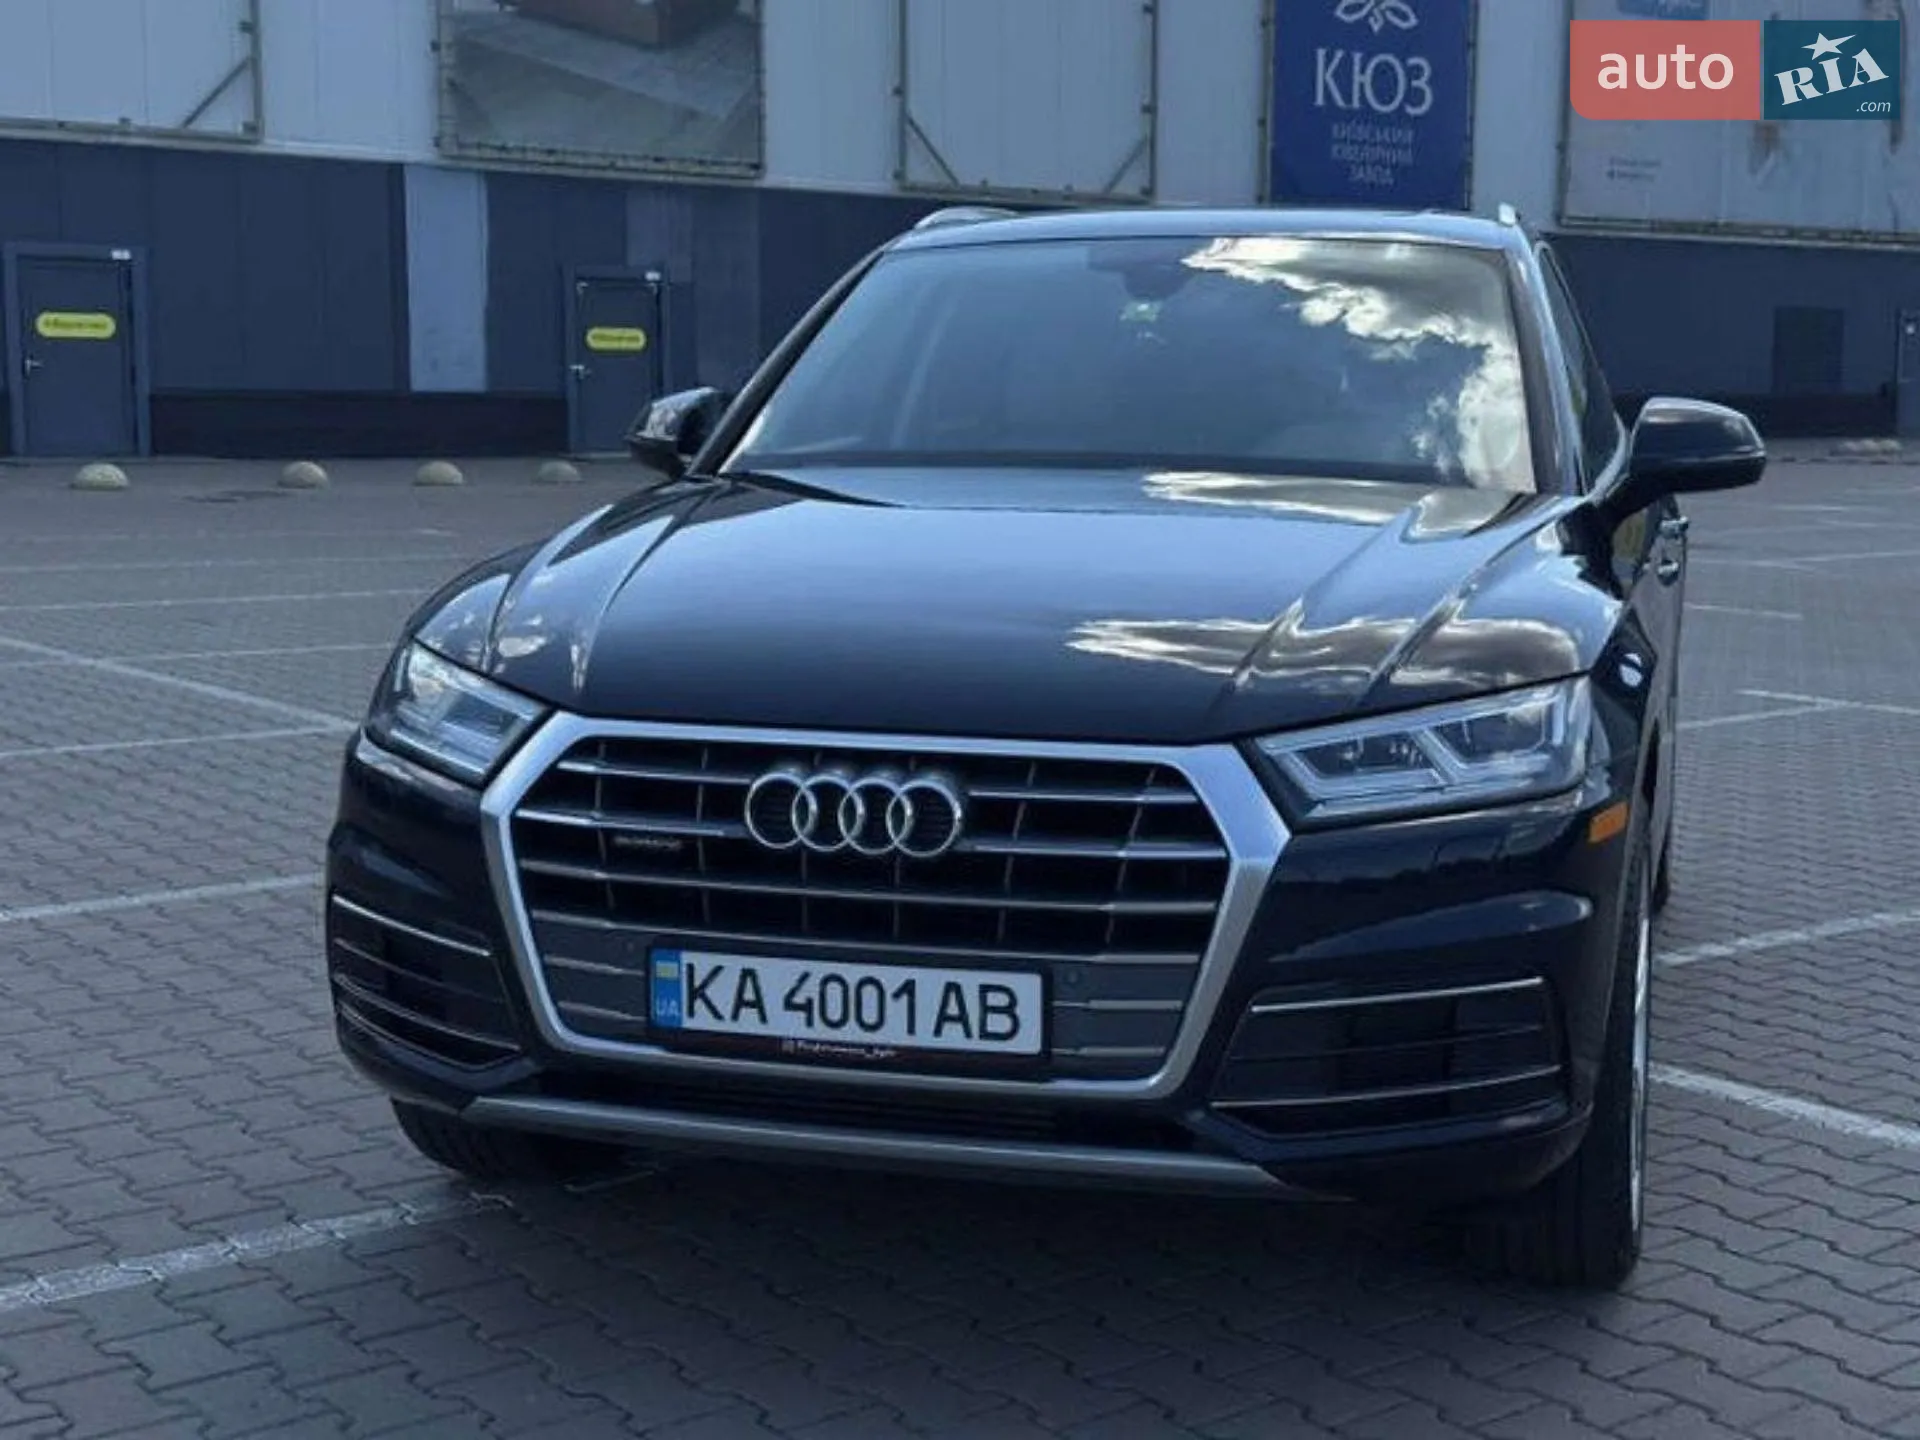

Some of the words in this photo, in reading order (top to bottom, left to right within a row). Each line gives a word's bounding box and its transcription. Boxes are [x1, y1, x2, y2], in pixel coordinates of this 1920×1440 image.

[1313, 48, 1433, 116] КЮЗ
[686, 962, 768, 1025] KA
[783, 971, 917, 1036] 4001
[933, 981, 1020, 1041] AB
